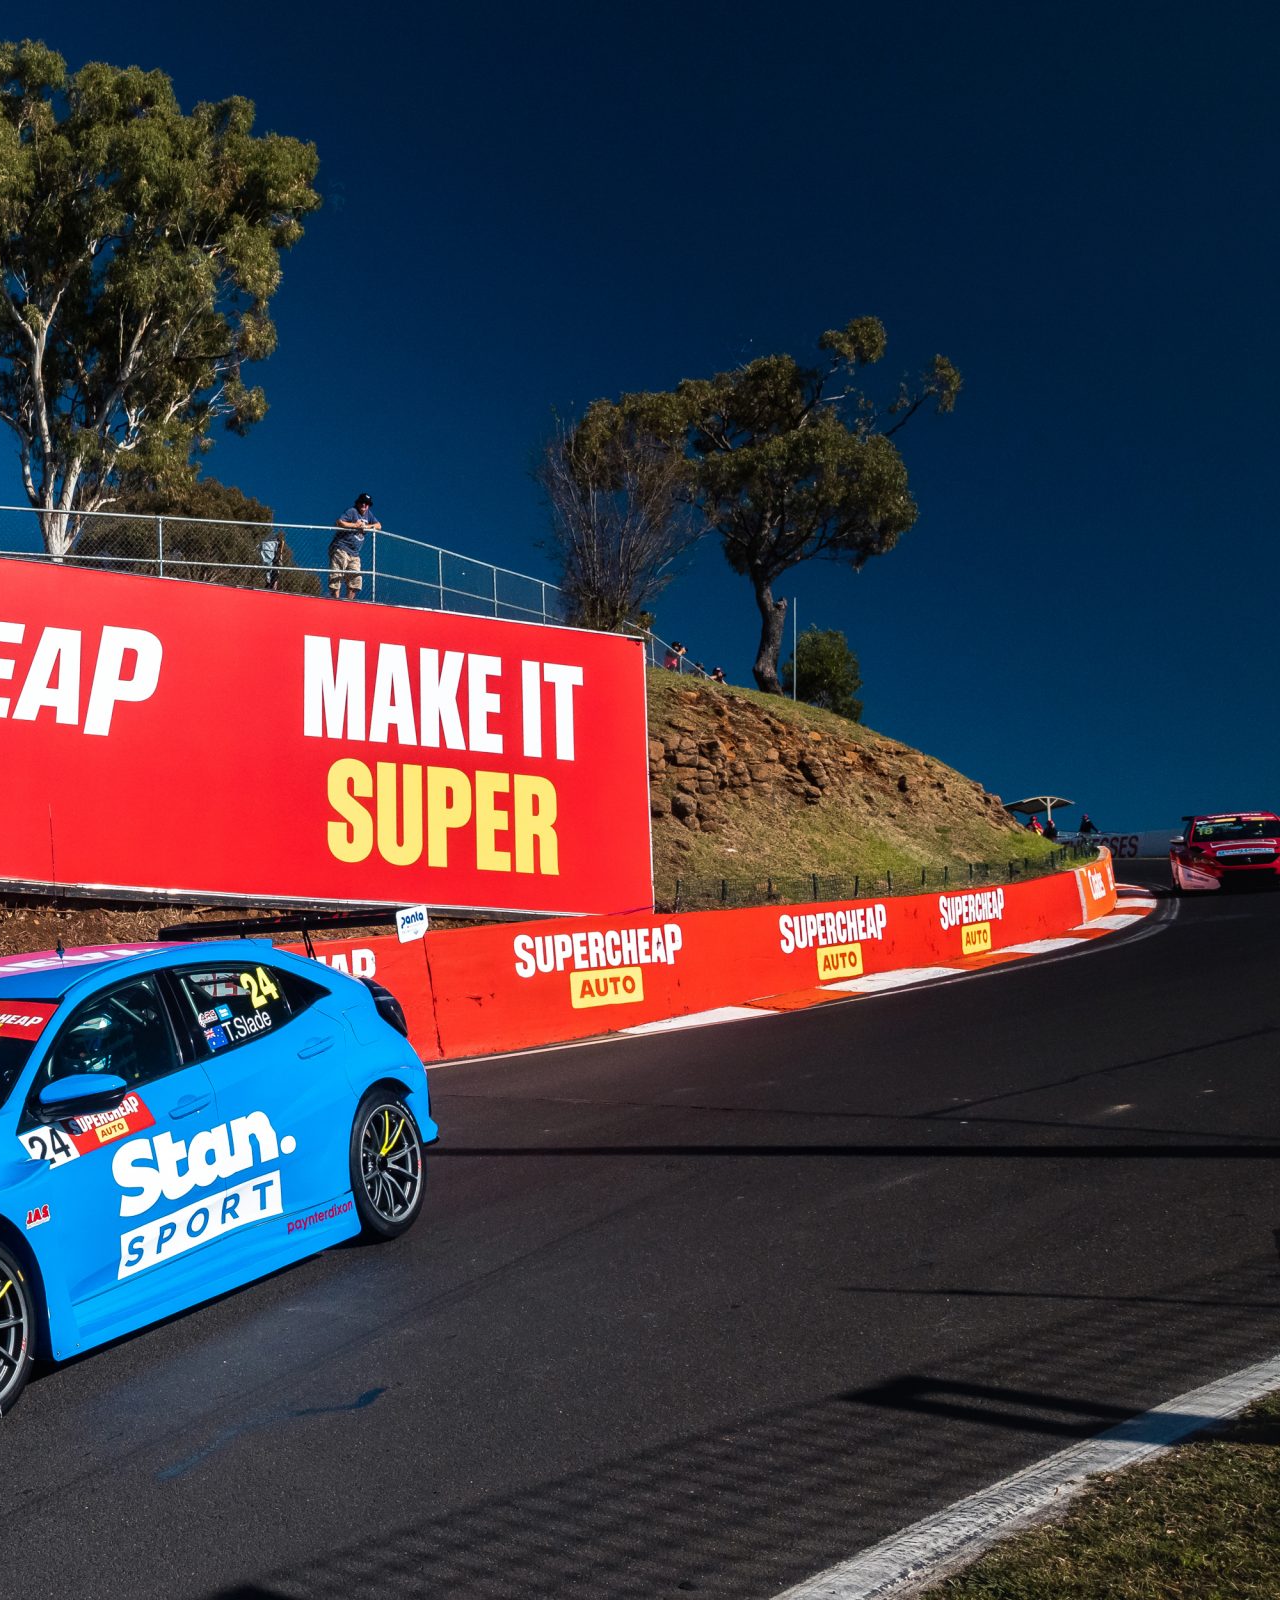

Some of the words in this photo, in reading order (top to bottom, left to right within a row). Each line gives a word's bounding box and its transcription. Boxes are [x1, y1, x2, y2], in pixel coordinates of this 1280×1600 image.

[304, 635, 504, 754] MAKE
[521, 659, 584, 762] IT
[327, 758, 560, 876] SUPER
[778, 903, 887, 954] SUPERCHEAP
[938, 887, 1005, 931] SUPERCHEAP
[513, 923, 683, 979] SUPERCHEAP
[965, 929, 988, 946] AUTO
[823, 951, 857, 971] AUTO
[240, 966, 280, 1009] 24
[580, 975, 636, 998] AUTO
[221, 1009, 272, 1041] T.Slade
[28, 1127, 72, 1165] 24
[100, 1121, 125, 1139] AUTO
[111, 1110, 297, 1218] Stan.
[26, 1203, 50, 1225] JAS
[124, 1179, 274, 1268] SPORT
[287, 1200, 353, 1235] paynterdixon
